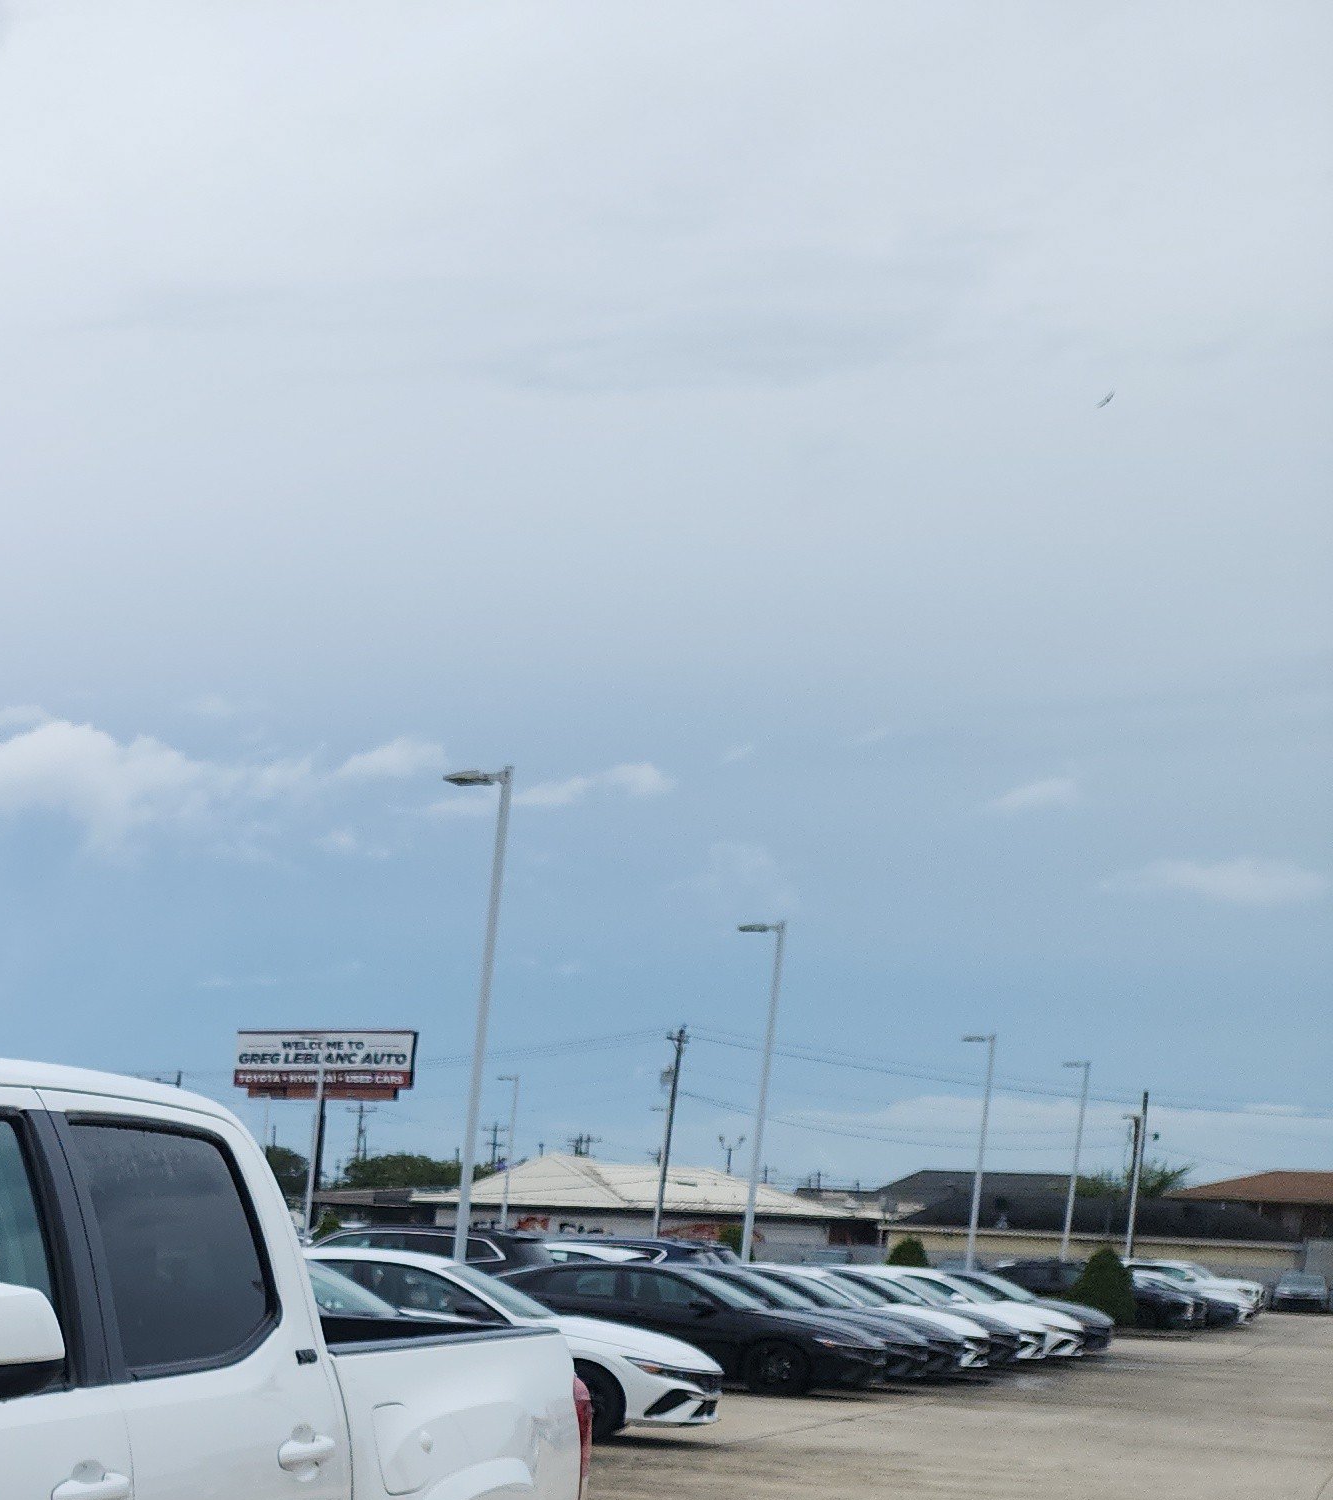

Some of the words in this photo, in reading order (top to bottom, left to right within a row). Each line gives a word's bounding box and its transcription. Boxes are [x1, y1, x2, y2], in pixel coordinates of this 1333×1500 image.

[347, 1041, 364, 1050] TO
[238, 1053, 281, 1064] GREG
[361, 1053, 407, 1065] AUTO
[238, 1074, 281, 1083] TOYOTA
[289, 1074, 336, 1083] HYUNAI
[346, 1075, 373, 1083] USED
[374, 1075, 404, 1084] CARS
